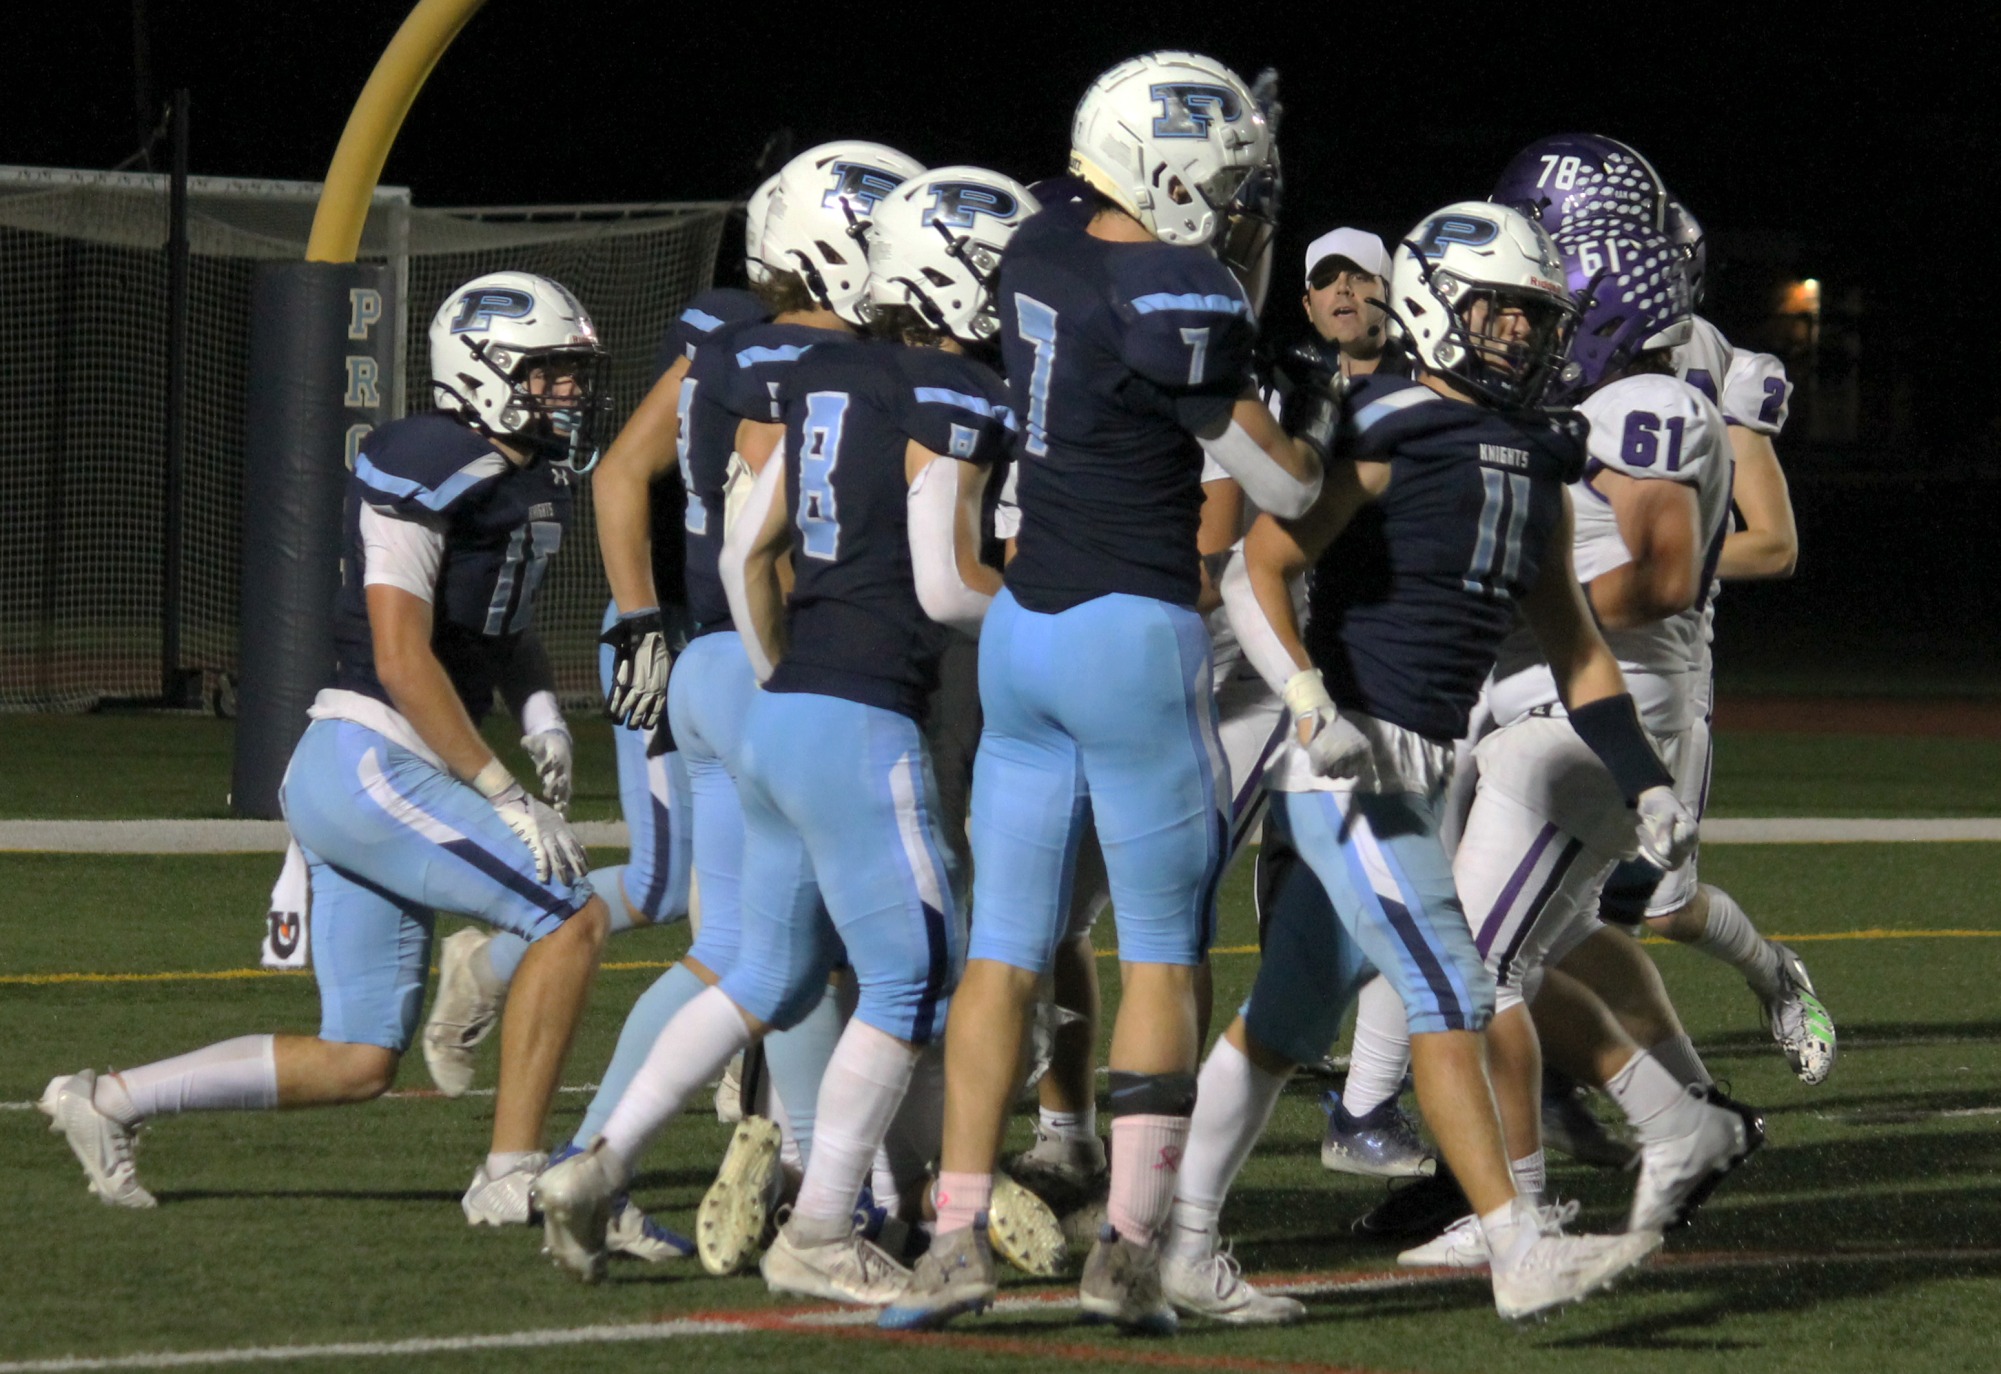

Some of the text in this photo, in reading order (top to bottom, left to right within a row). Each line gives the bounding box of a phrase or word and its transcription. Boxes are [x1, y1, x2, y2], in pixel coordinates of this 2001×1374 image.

[1537, 154, 1581, 191] 78
[922, 181, 1018, 228] P
[1407, 215, 1499, 259] P
[1578, 237, 1620, 277] 61
[450, 287, 535, 334] P
[1014, 291, 1058, 458] 7
[1179, 327, 1210, 386] 7
[1760, 377, 1785, 423] 2
[1479, 442, 1530, 469] KNIGHTS
[1620, 410, 1686, 471] 61
[796, 390, 850, 561] 8
[1463, 466, 1531, 598] 11
[482, 521, 562, 637] 17
